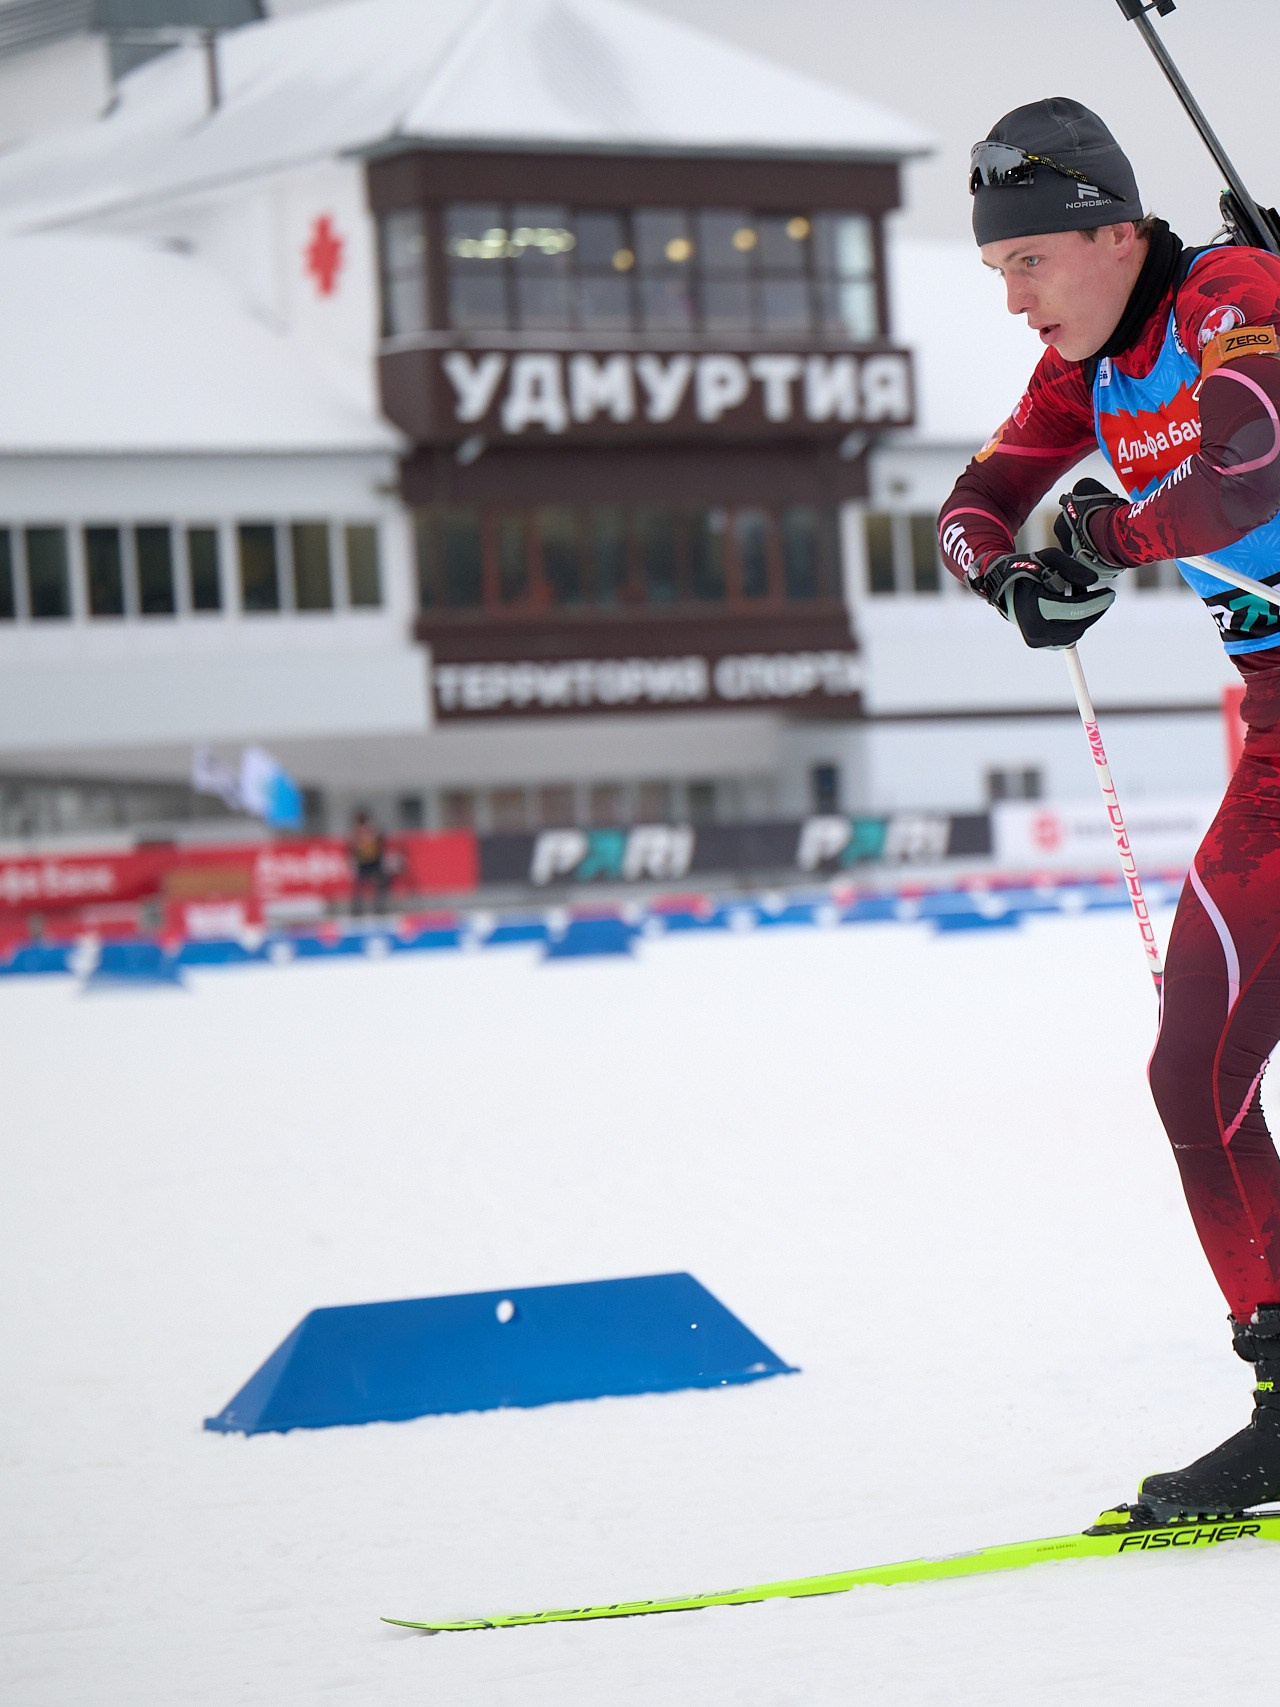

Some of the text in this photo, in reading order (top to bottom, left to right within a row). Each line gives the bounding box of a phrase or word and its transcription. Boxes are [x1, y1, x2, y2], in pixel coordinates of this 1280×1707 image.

[1065, 198, 1113, 210] NORDSKI
[1225, 334, 1273, 353] ZERO
[442, 351, 912, 434] УДМУРТИЯ
[1117, 417, 1202, 464] Альфа Бан
[534, 826, 695, 885] PARI
[799, 812, 951, 870] PARI
[1256, 1381, 1274, 1391] ER
[1118, 1523, 1262, 1553] FISCHER
